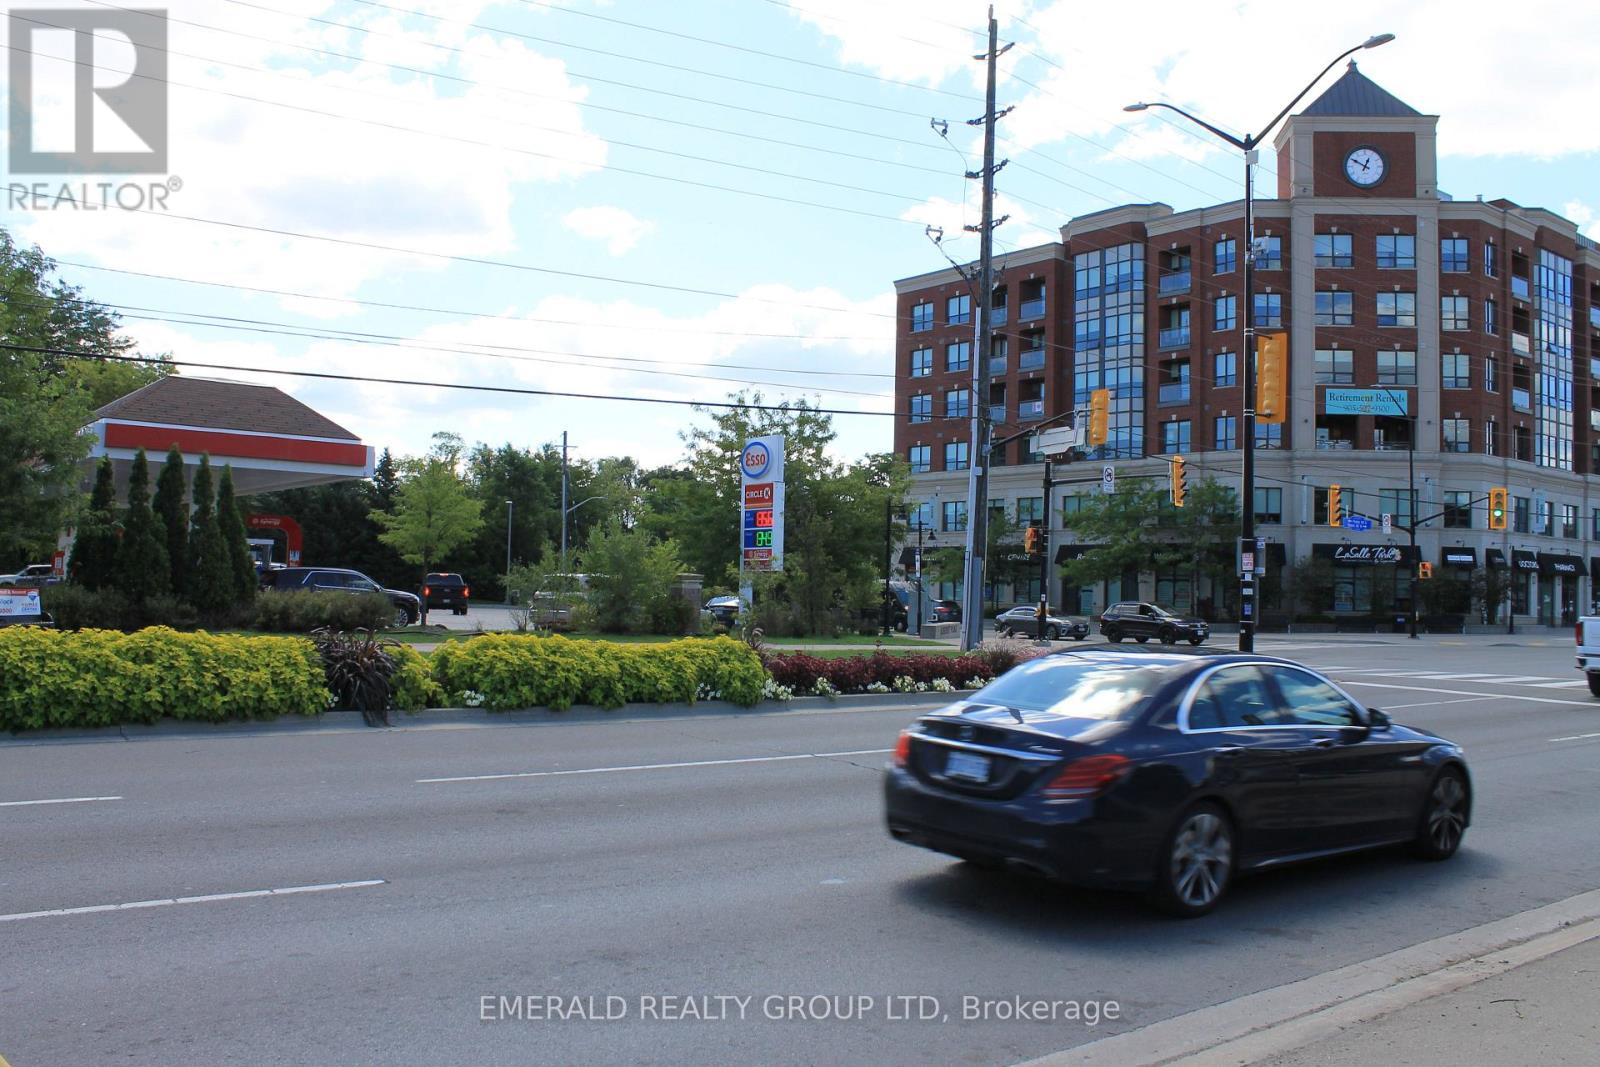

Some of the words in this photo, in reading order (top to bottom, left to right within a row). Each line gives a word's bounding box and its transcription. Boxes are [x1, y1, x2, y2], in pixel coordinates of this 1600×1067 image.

[1329, 392, 1374, 402] Retirement
[1375, 393, 1405, 403] Rentals
[1334, 546, 1371, 559] LaSalle
